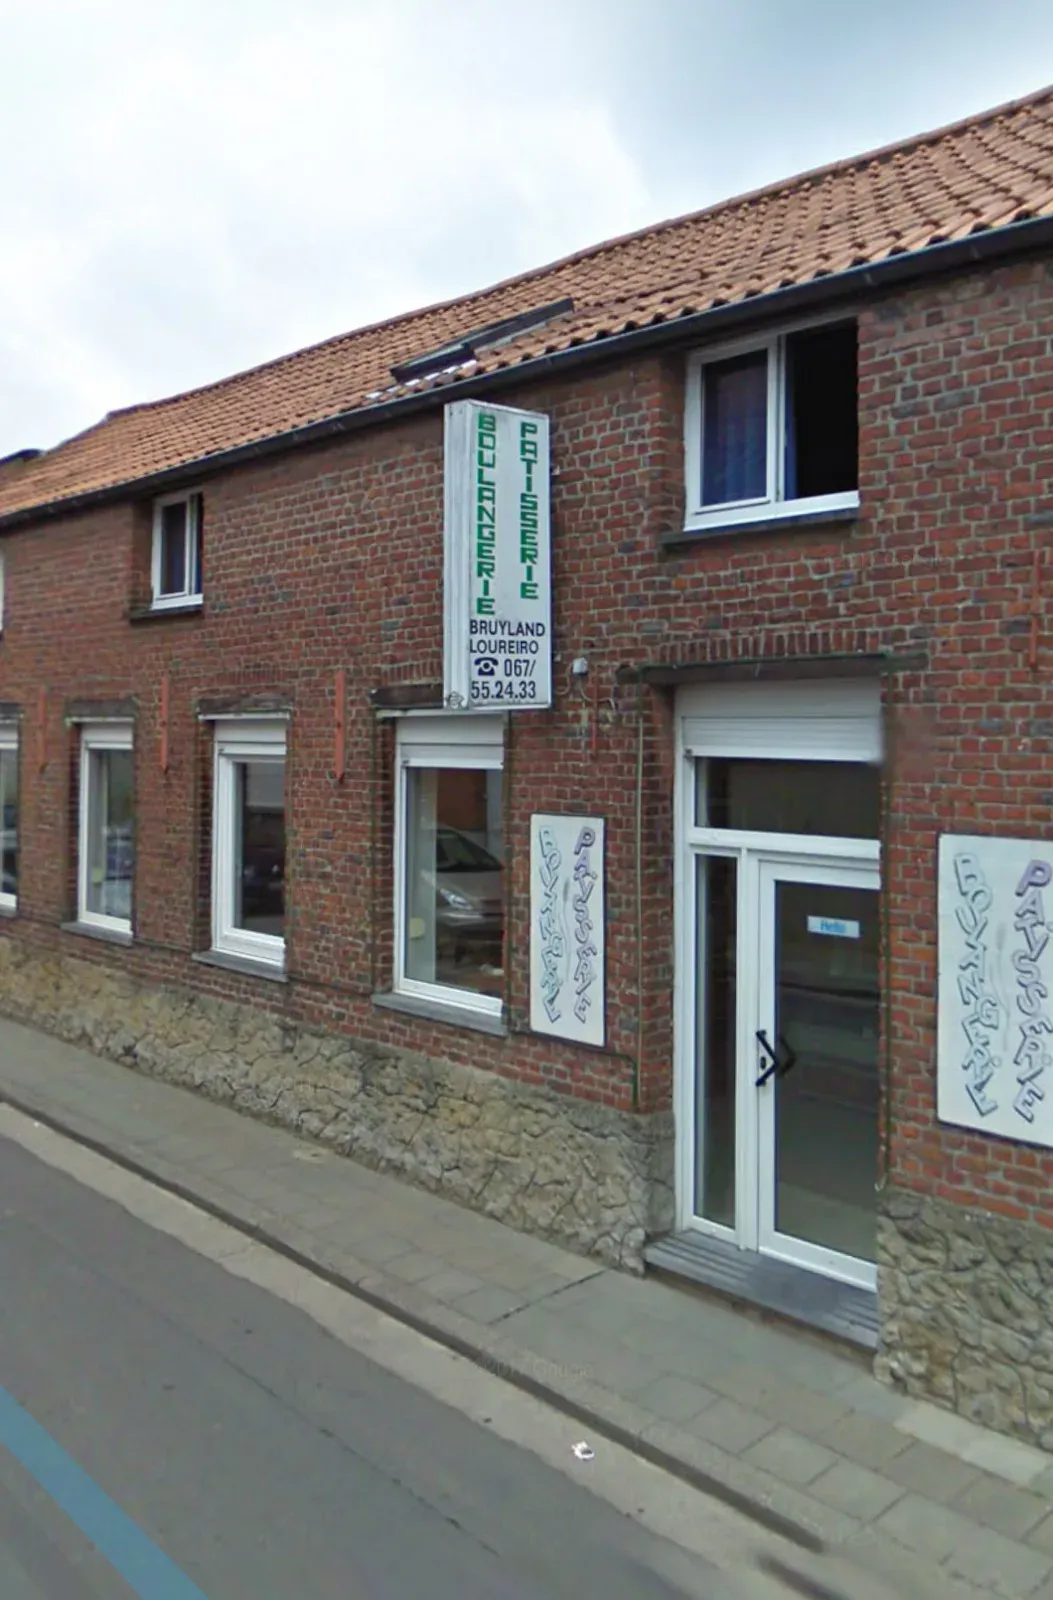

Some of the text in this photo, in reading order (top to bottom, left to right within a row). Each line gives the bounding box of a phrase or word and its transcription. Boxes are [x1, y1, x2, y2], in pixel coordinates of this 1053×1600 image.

[477, 411, 496, 615] BOULANGERIE
[520, 421, 538, 599] PATISSERIE
[469, 619, 545, 637] BRUYLAND
[469, 639, 539, 654] LOUREIRO
[503, 659, 536, 677] 067/
[471, 681, 536, 699] 55.24.33
